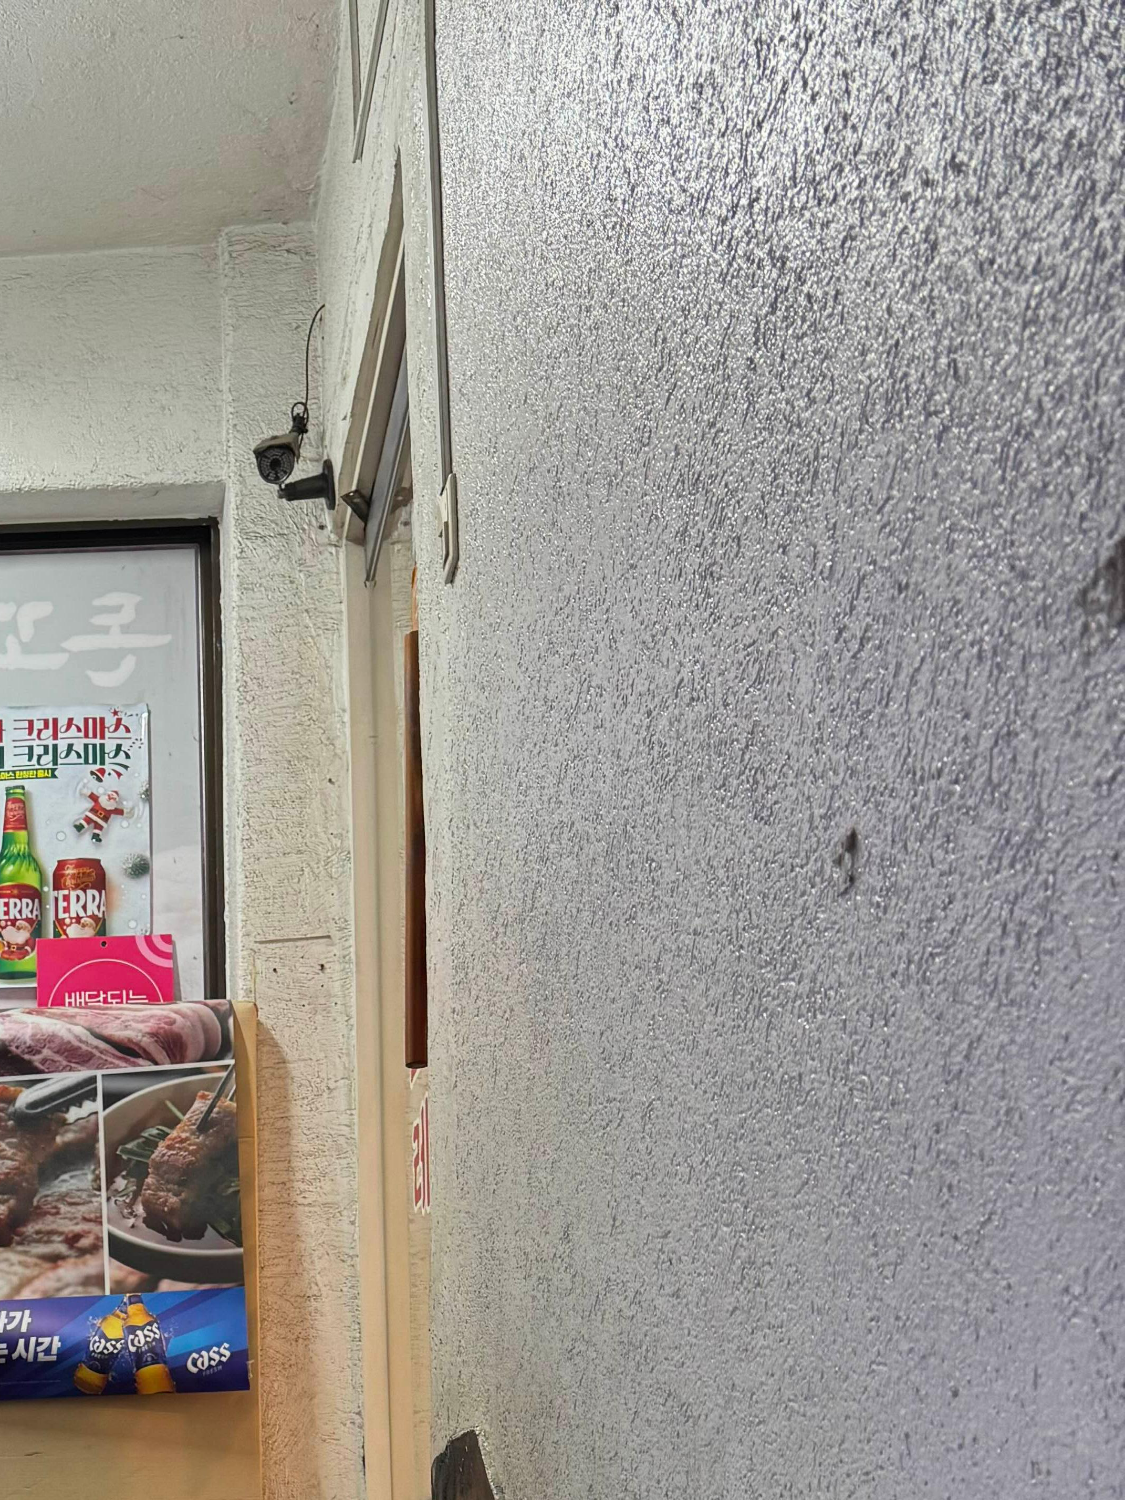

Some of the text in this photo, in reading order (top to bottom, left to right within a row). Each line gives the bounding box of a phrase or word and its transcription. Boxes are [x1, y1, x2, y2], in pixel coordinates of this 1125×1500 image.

[12, 717, 132, 742] 크리스마스
[12, 743, 131, 766] 크리스마스
[53, 890, 106, 919] TERRA
[10, 1336, 61, 1363] 시간
